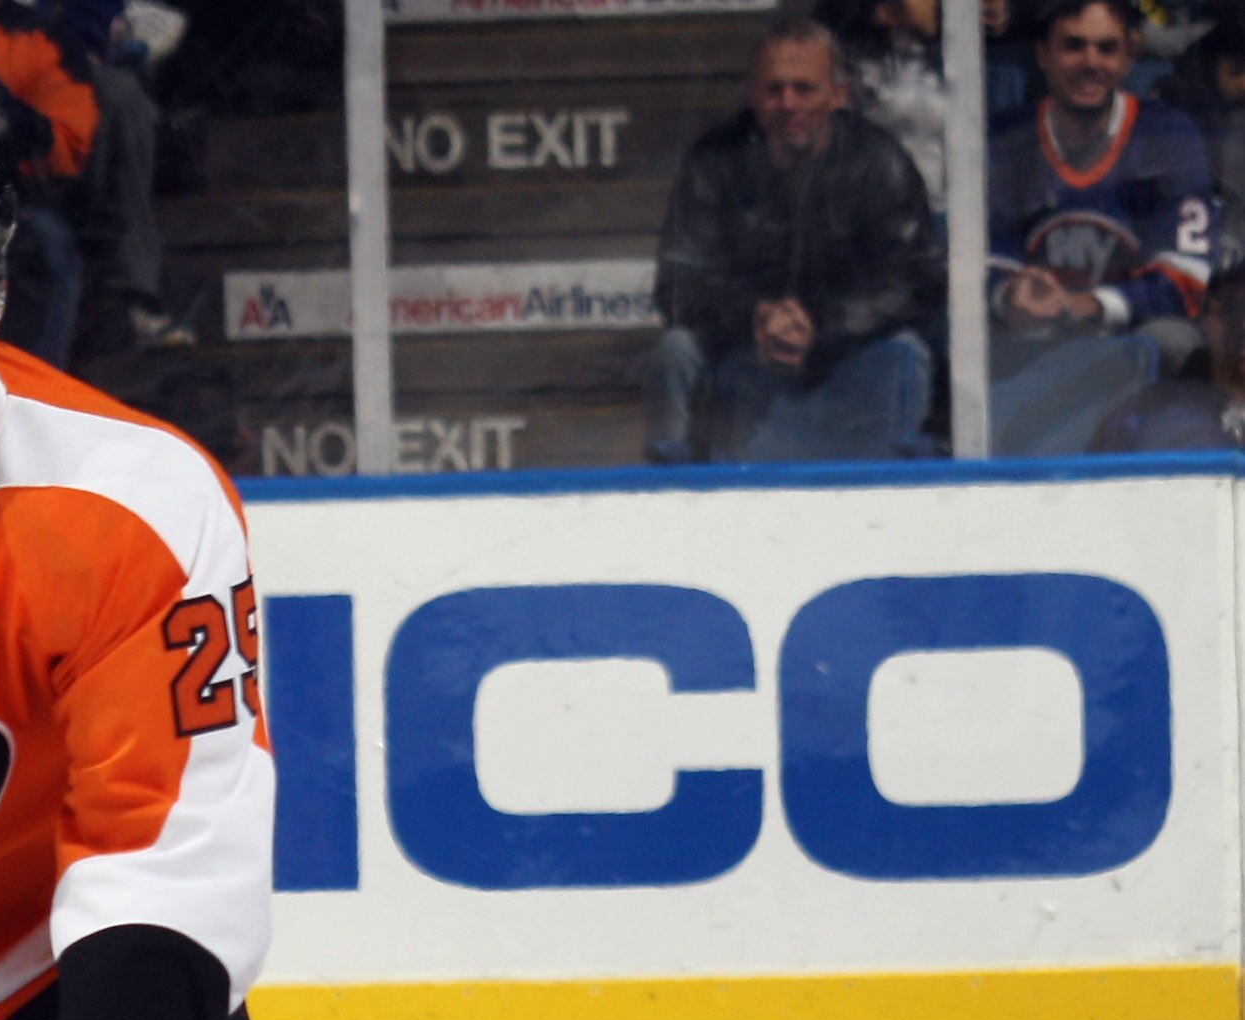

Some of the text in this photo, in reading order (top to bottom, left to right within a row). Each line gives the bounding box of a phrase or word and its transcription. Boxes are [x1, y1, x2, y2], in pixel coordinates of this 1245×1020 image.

[385, 108, 630, 174] NO EXIT
[1177, 198, 1210, 254] 2
[261, 416, 526, 476] NO EXIT
